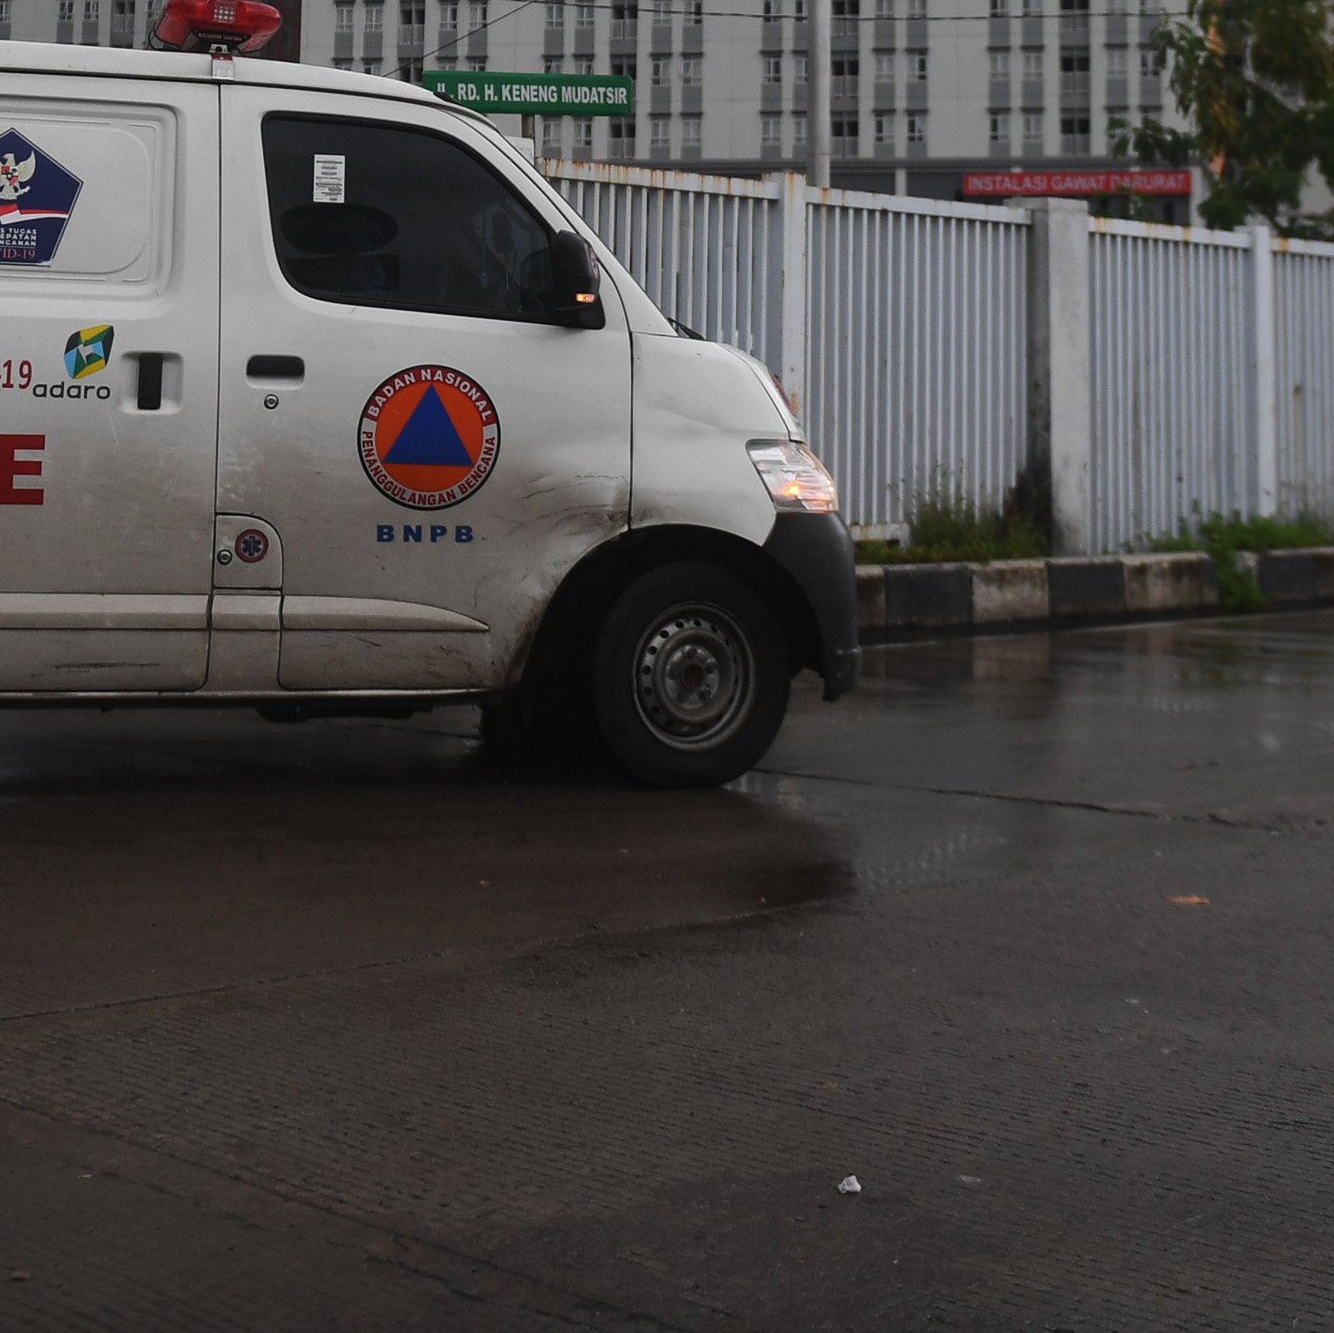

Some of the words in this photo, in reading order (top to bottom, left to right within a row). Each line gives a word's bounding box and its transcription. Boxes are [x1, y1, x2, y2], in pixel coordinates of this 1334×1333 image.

[457, 83, 480, 101] RD.
[484, 84, 498, 101] H.
[501, 83, 558, 103] KENENG
[561, 85, 628, 105] MUDATSIR
[967, 174, 1047, 192] INSTALASI
[1051, 174, 1107, 191] GAWAT
[8, 227, 37, 235] TUGAS
[32, 380, 112, 400] adaro
[367, 372, 416, 417] BADAN
[421, 369, 492, 422] NASIONAL
[361, 430, 457, 506] PENANGGULANGAN
[458, 436, 496, 496] BENCANA
[376, 524, 474, 543] BNPB
